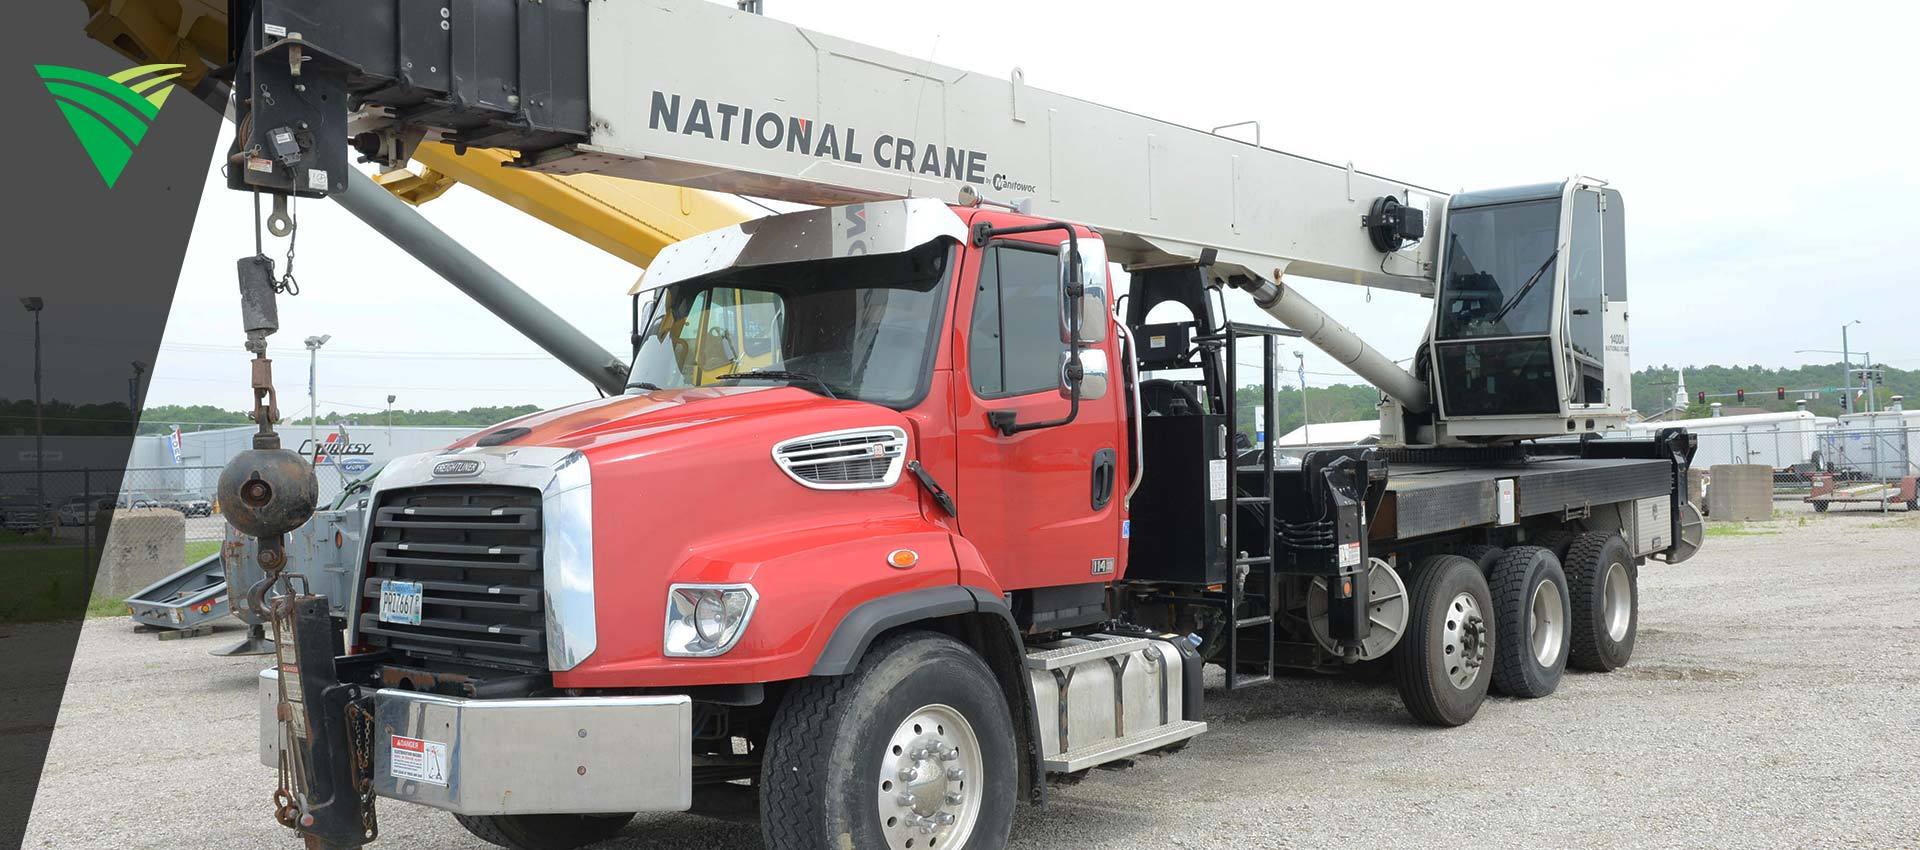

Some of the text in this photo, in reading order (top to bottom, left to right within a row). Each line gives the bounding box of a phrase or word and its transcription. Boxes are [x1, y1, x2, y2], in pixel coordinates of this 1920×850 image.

[649, 90, 988, 185] NATIONAL CRANE
[993, 173, 1036, 192] Manitowoc
[434, 462, 478, 473] FREIGHTLINER
[1093, 560, 1106, 572] 114
